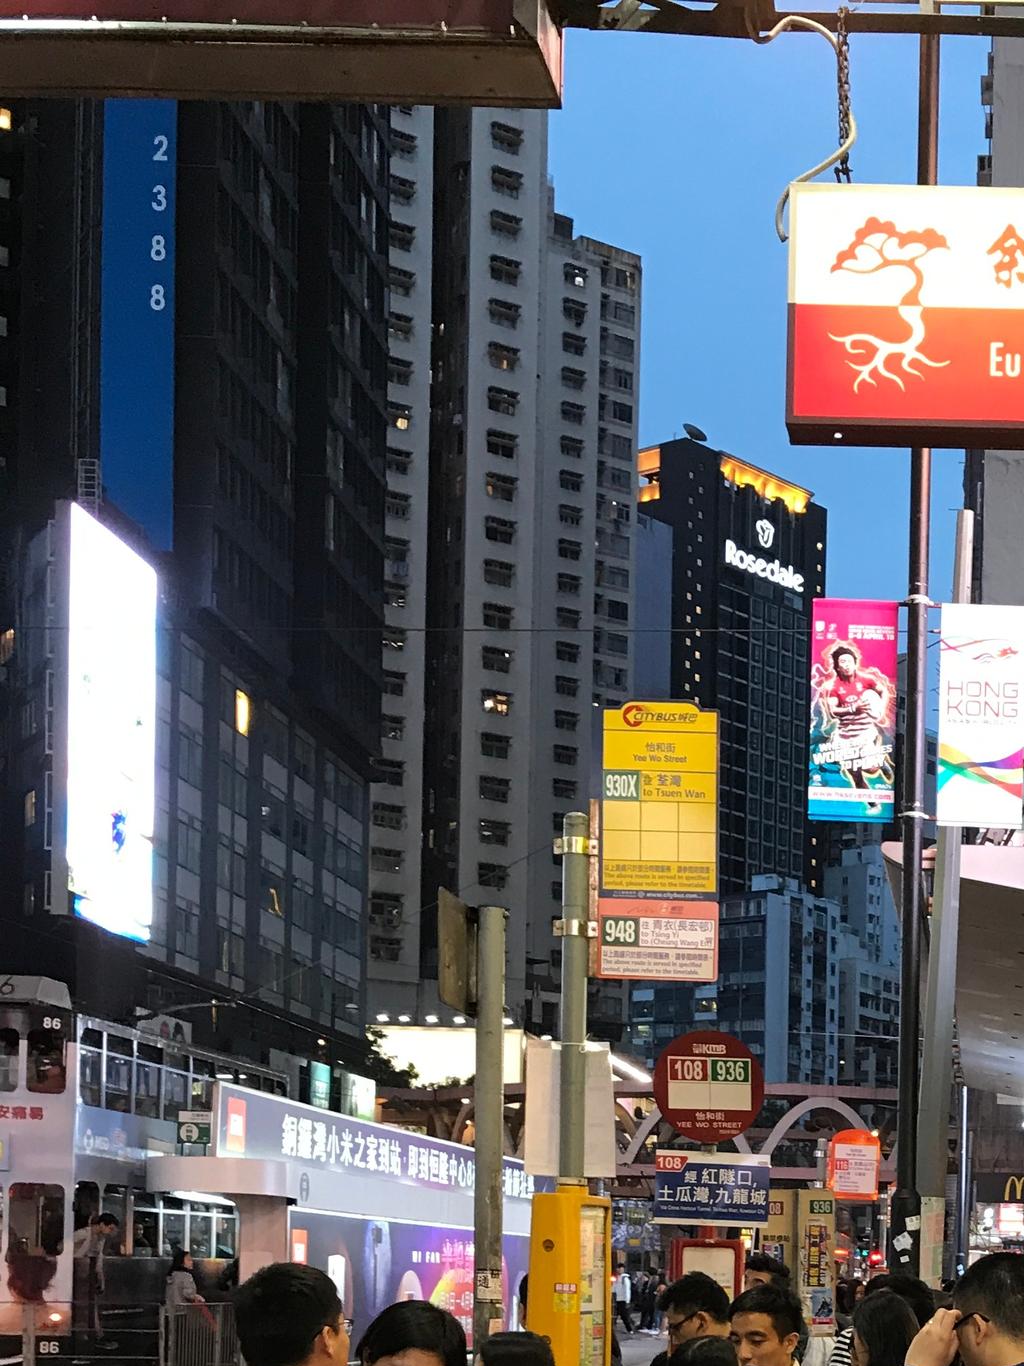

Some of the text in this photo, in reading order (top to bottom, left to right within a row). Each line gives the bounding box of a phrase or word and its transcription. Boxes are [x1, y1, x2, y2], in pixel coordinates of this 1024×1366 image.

[989, 341, 1021, 378] Eu
[725, 538, 805, 593] Rosedale
[946, 679, 1019, 699] HONG
[633, 711, 677, 722] CITYBUS
[946, 701, 1019, 719] KONG
[633, 754, 688, 763] Yee Wo Street
[606, 774, 637, 797] 930X
[643, 788, 706, 799] to Tsuen Wan
[605, 919, 636, 943] 948
[651, 931, 670, 939] Tsing
[680, 941, 699, 949] Wang
[43, 1016, 62, 1030] 86
[674, 1060, 703, 1080] 108
[717, 1061, 745, 1081] 936
[712, 1121, 742, 1129] STREET
[657, 1157, 682, 1169] 108
[684, 1170, 698, 1183] 經
[769, 1202, 781, 1214] 08
[813, 1201, 831, 1213] 936
[39, 1340, 60, 1354] 86
